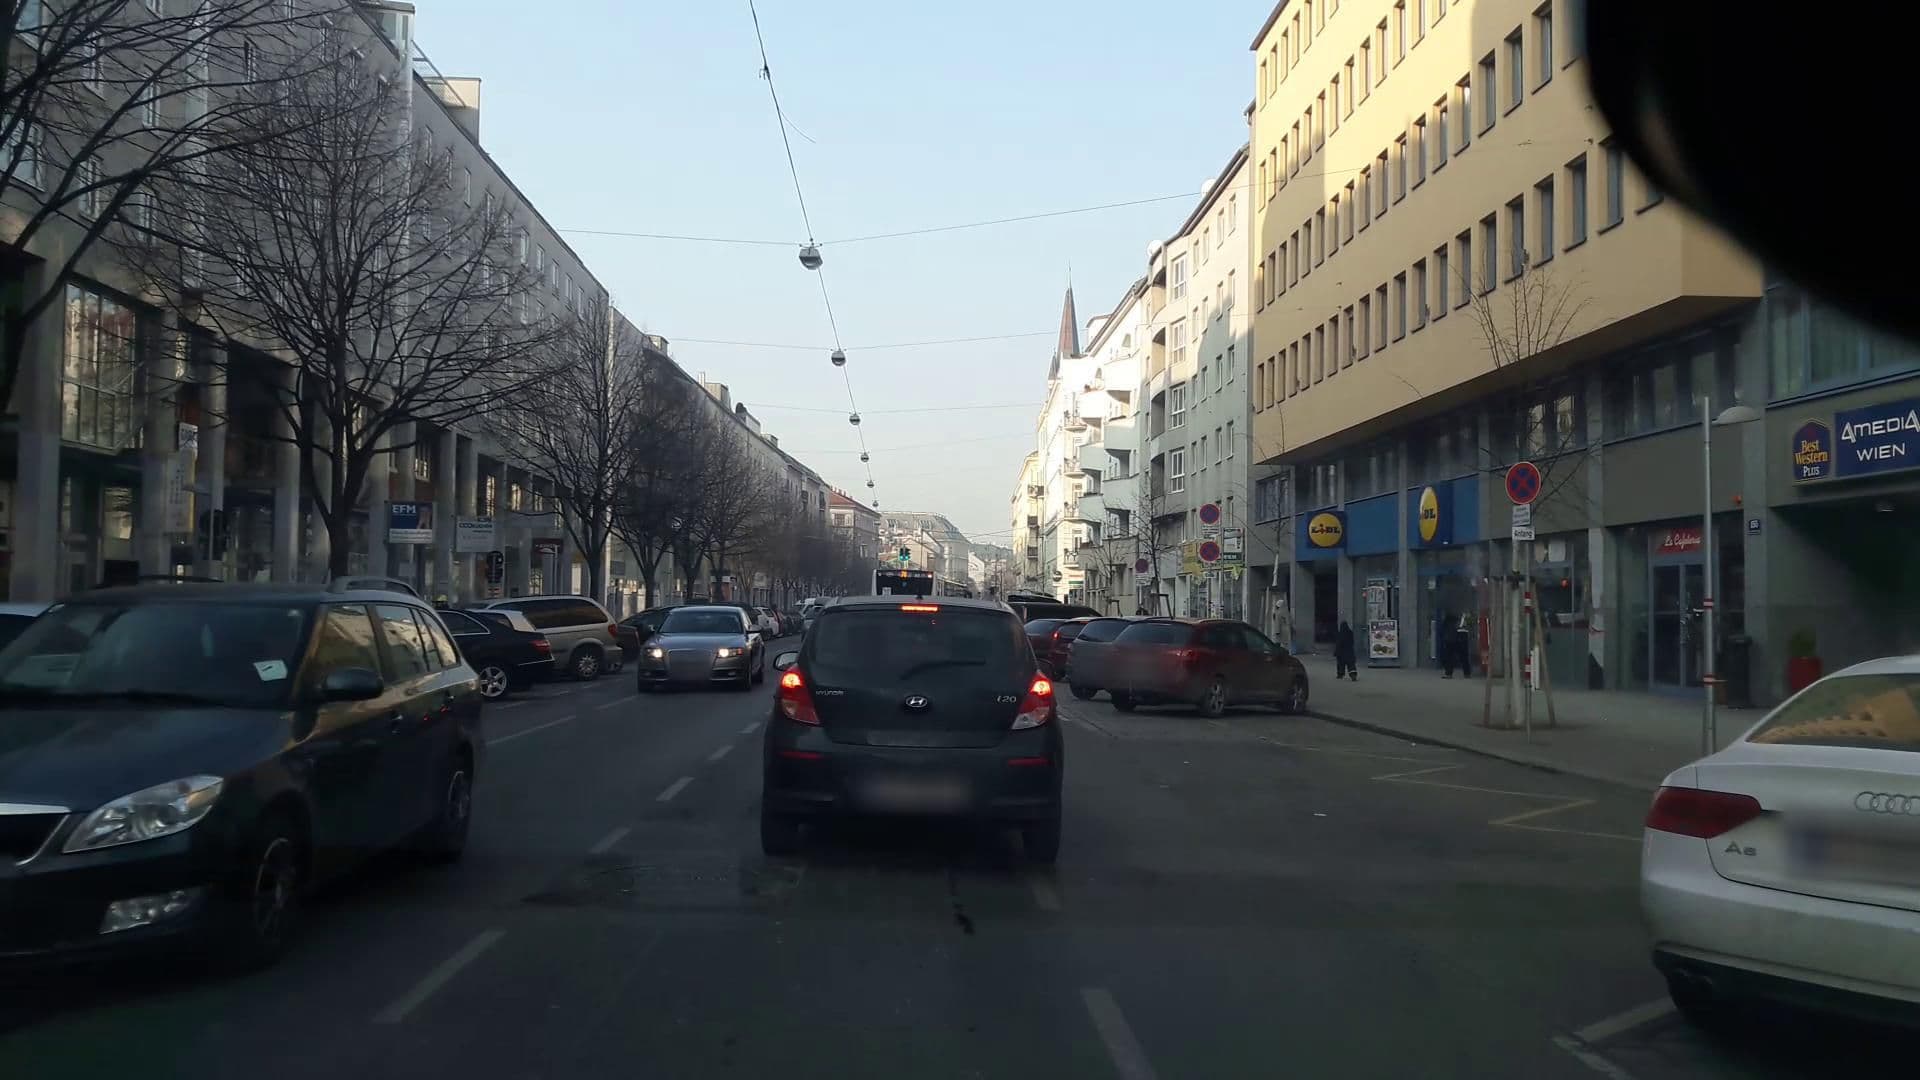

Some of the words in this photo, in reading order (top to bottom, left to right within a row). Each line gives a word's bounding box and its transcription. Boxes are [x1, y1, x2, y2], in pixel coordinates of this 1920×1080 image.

[1841, 409, 1920, 443] AMEDIA
[1801, 439, 1820, 453] Best
[1856, 442, 1906, 462] WIEN
[1794, 451, 1828, 464] Western
[392, 505, 417, 514] EFM
